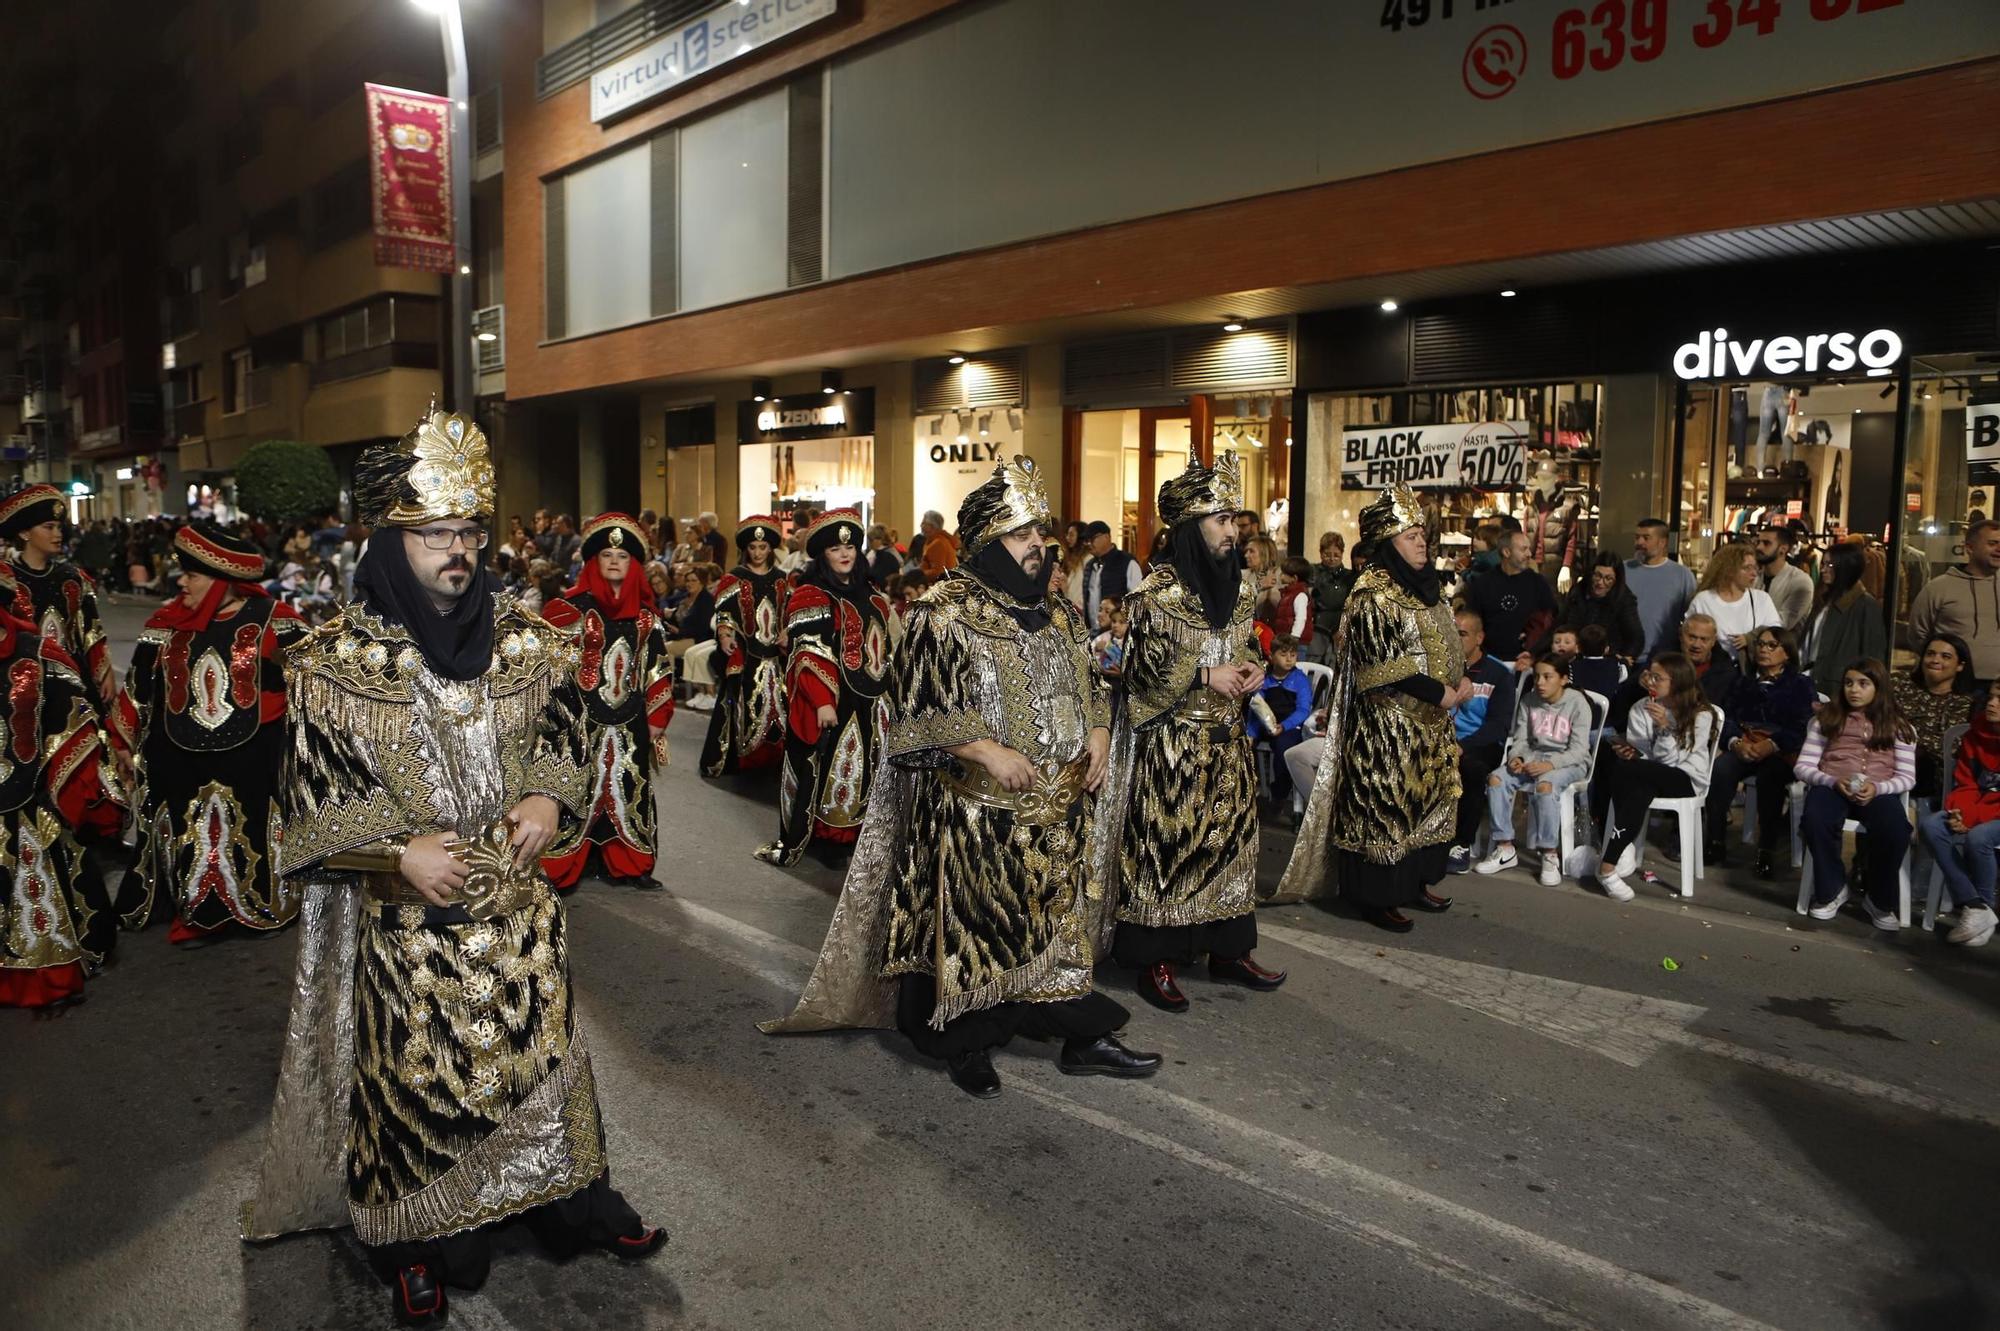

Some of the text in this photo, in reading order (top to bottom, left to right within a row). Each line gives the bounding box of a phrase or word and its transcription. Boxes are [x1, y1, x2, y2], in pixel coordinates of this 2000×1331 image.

[1550, 0, 1668, 80] 639
[601, 41, 679, 99] virtud
[1672, 328, 1902, 381] diverso
[930, 442, 1004, 463] ONLY
[1346, 431, 1456, 463] BLACK diverso
[1463, 435, 1489, 447] HASTA
[1366, 454, 1450, 485] FRIDAY
[1460, 442, 1523, 487] 50%
